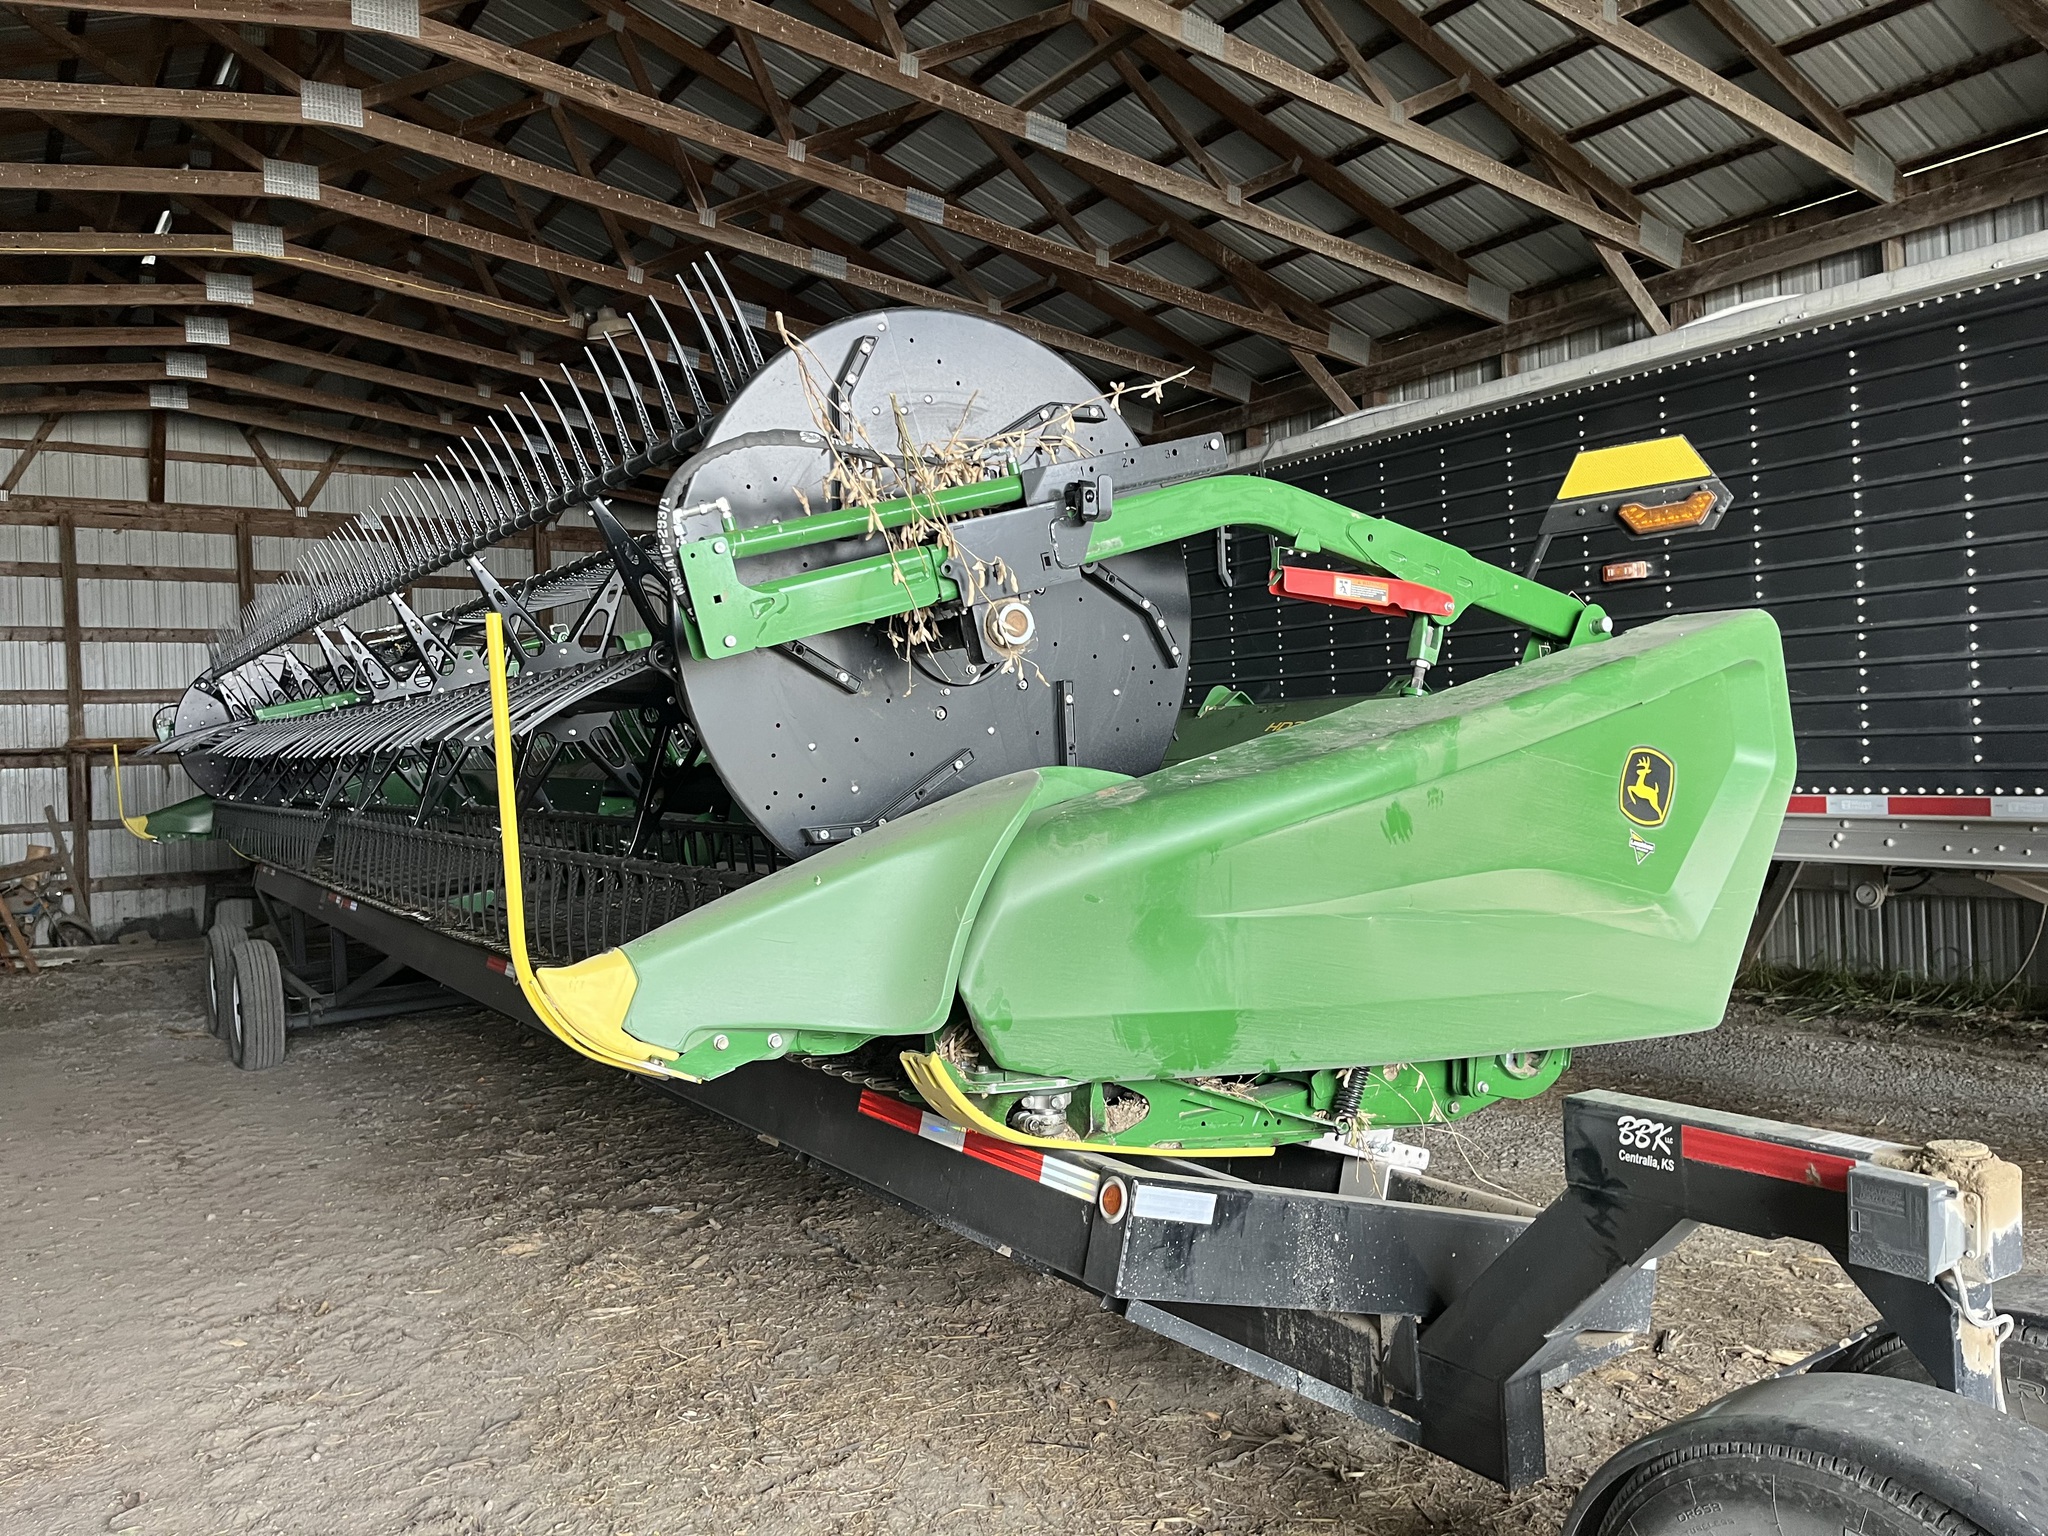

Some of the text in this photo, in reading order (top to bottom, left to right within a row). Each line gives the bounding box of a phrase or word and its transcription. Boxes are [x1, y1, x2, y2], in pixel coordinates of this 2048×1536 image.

[1121, 457, 1129, 468] 2
[1164, 449, 1171, 460] 3
[1203, 442, 1209, 450] 4
[1617, 1115, 1674, 1156] BBK LLC
[1618, 1149, 1675, 1172] Centralia, KS
